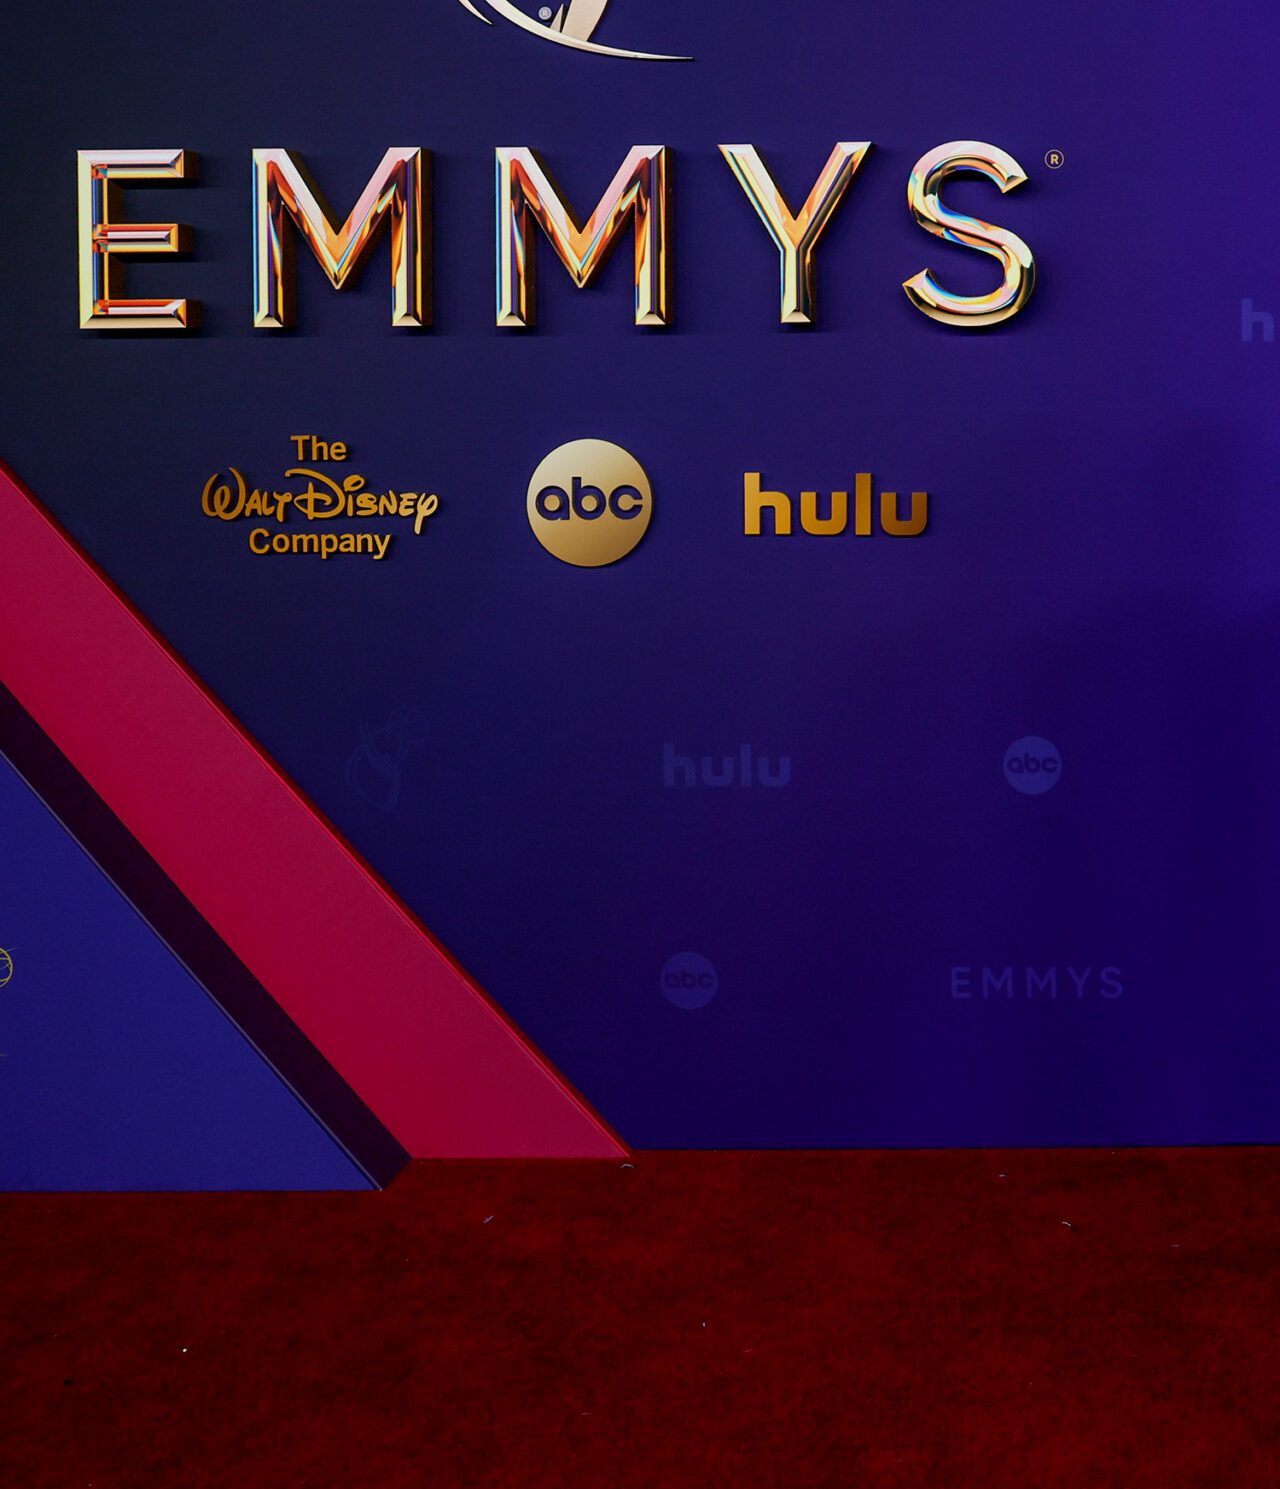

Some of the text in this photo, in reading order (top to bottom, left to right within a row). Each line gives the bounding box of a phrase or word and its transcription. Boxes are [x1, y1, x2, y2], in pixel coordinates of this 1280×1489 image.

[289, 434, 350, 461] The
[535, 477, 643, 521] abc
[744, 472, 929, 537] hulu
[249, 528, 392, 560] Company
[662, 743, 792, 787] hulu
[1008, 753, 1057, 773] abc
[664, 970, 713, 988] abc
[950, 966, 1124, 999] EMMYS
